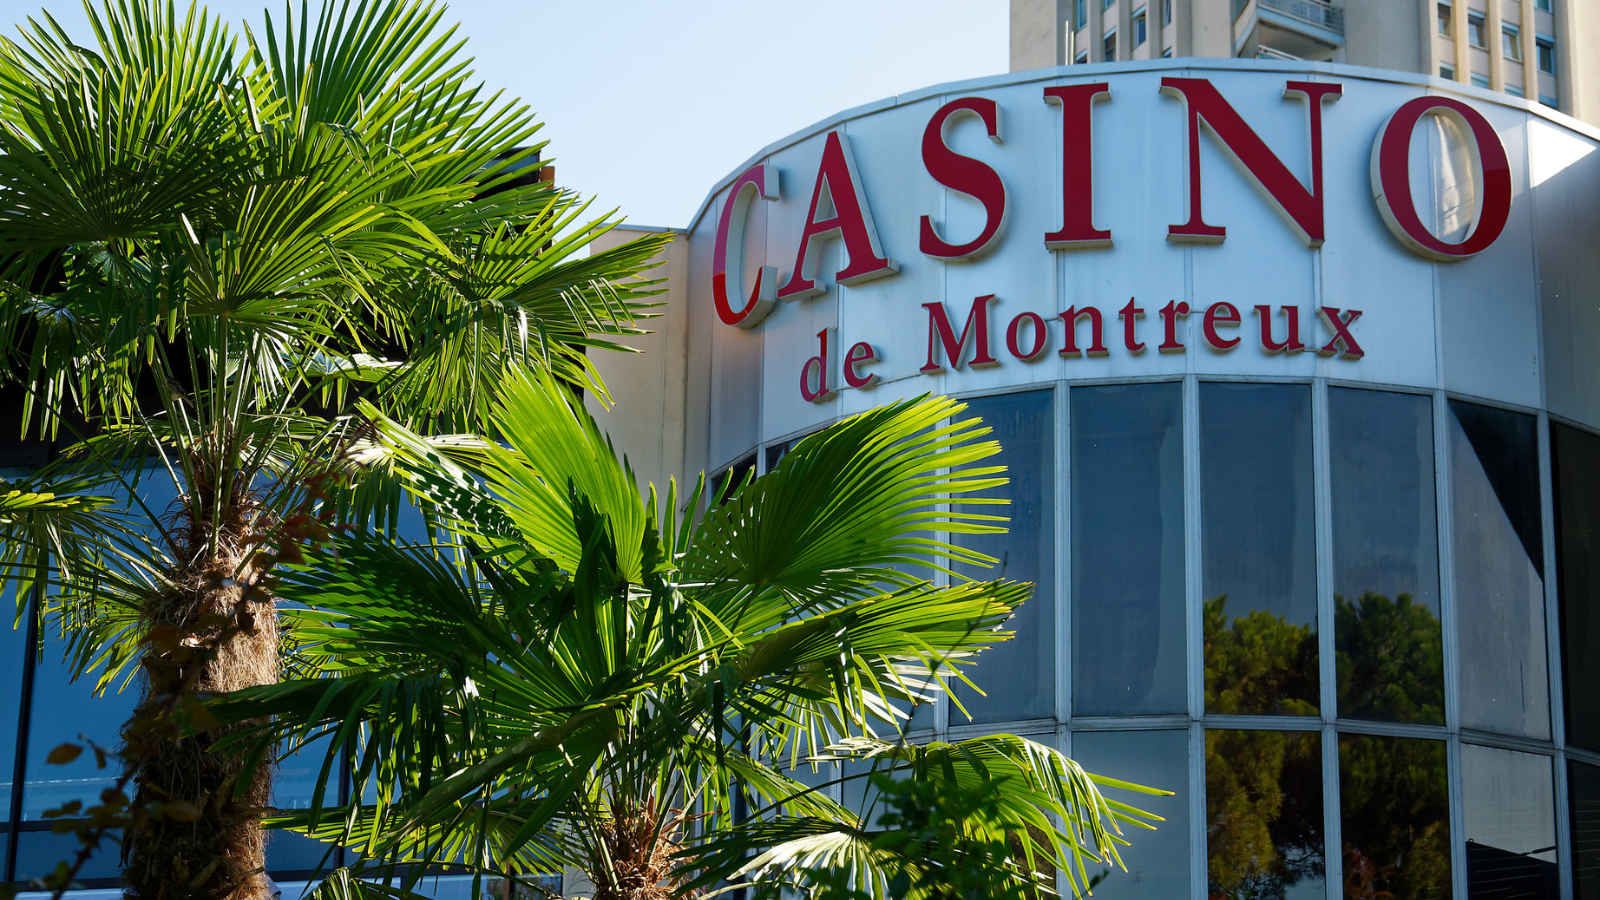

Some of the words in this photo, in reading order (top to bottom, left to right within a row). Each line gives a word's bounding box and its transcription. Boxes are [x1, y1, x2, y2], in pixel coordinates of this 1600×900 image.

[712, 77, 1512, 327] CASINO
[800, 328, 881, 403] de
[920, 294, 1364, 372] Montreux
